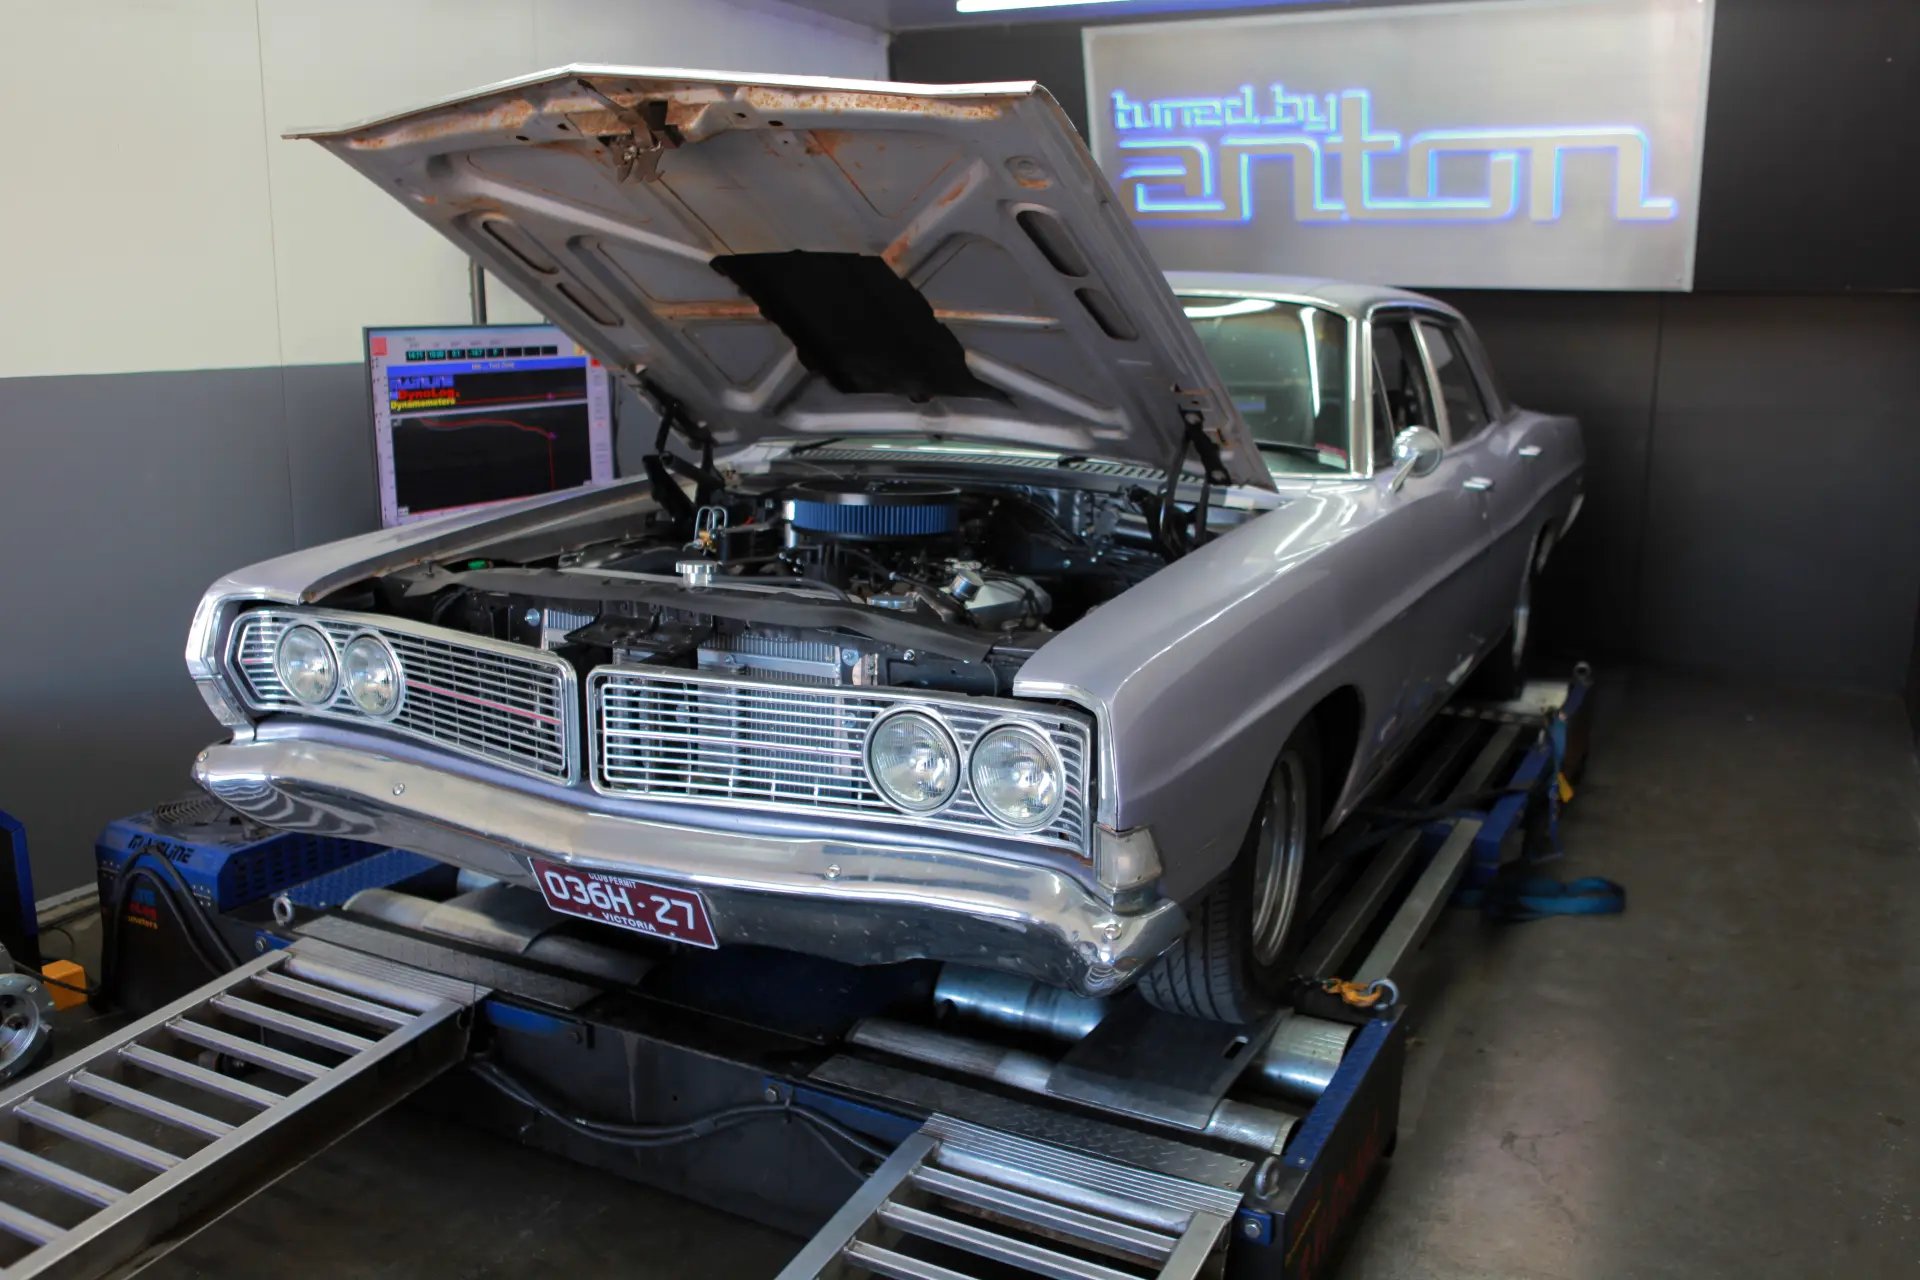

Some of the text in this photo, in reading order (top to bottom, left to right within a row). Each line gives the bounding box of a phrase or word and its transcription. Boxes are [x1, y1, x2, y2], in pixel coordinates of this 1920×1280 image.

[1261, 82, 1339, 134] by
[1117, 88, 1677, 222] anton
[588, 872, 637, 889] CLUB PERMIT
[602, 911, 657, 932] VICTORIA
